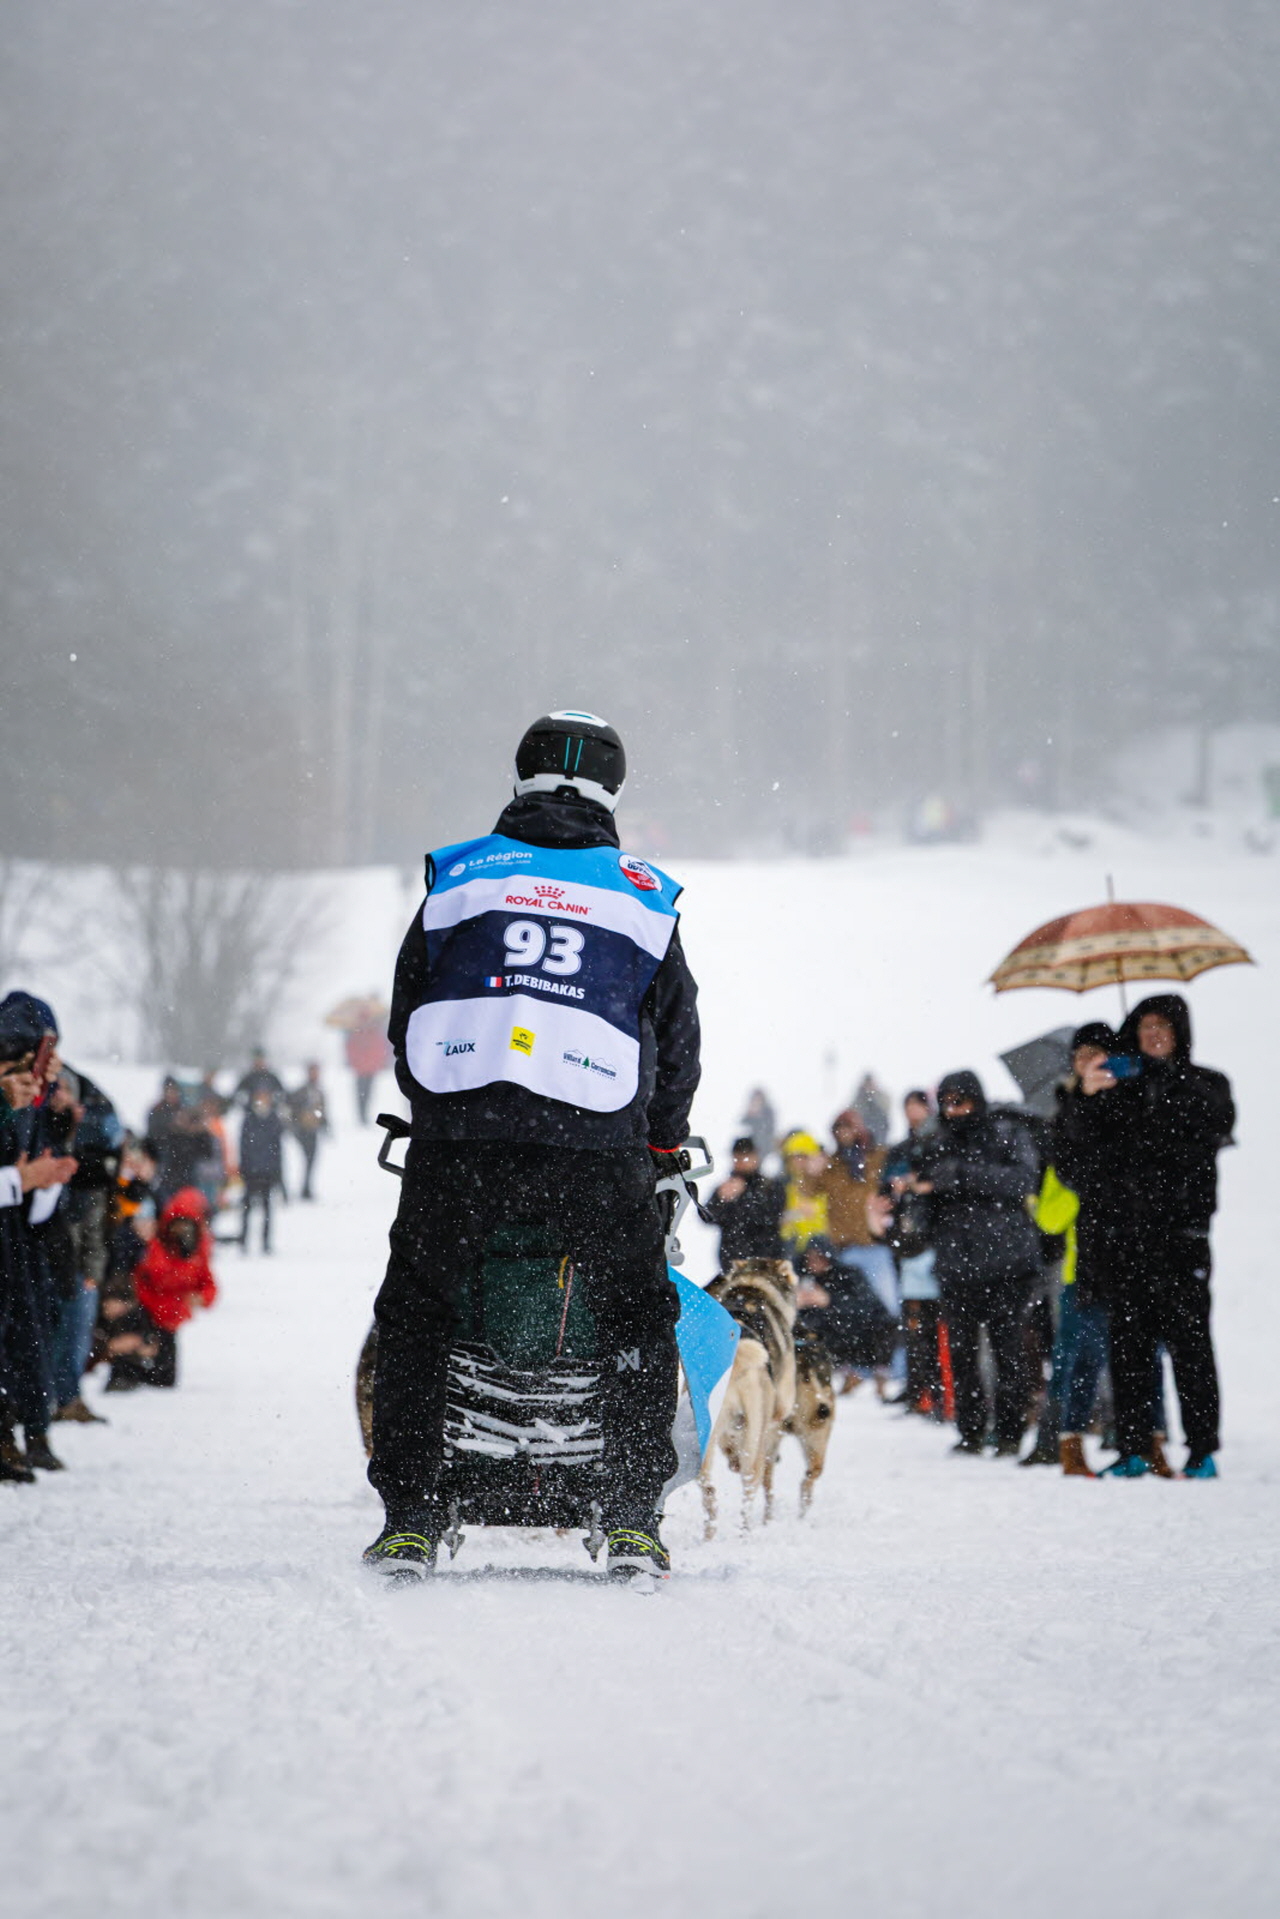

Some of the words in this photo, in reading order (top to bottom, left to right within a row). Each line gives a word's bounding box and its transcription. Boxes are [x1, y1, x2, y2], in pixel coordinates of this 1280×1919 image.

[486, 850, 533, 862] Région
[505, 895, 545, 908] ROYAL
[503, 920, 585, 976] 93
[504, 974, 586, 1000] T.DEBIBAKAS
